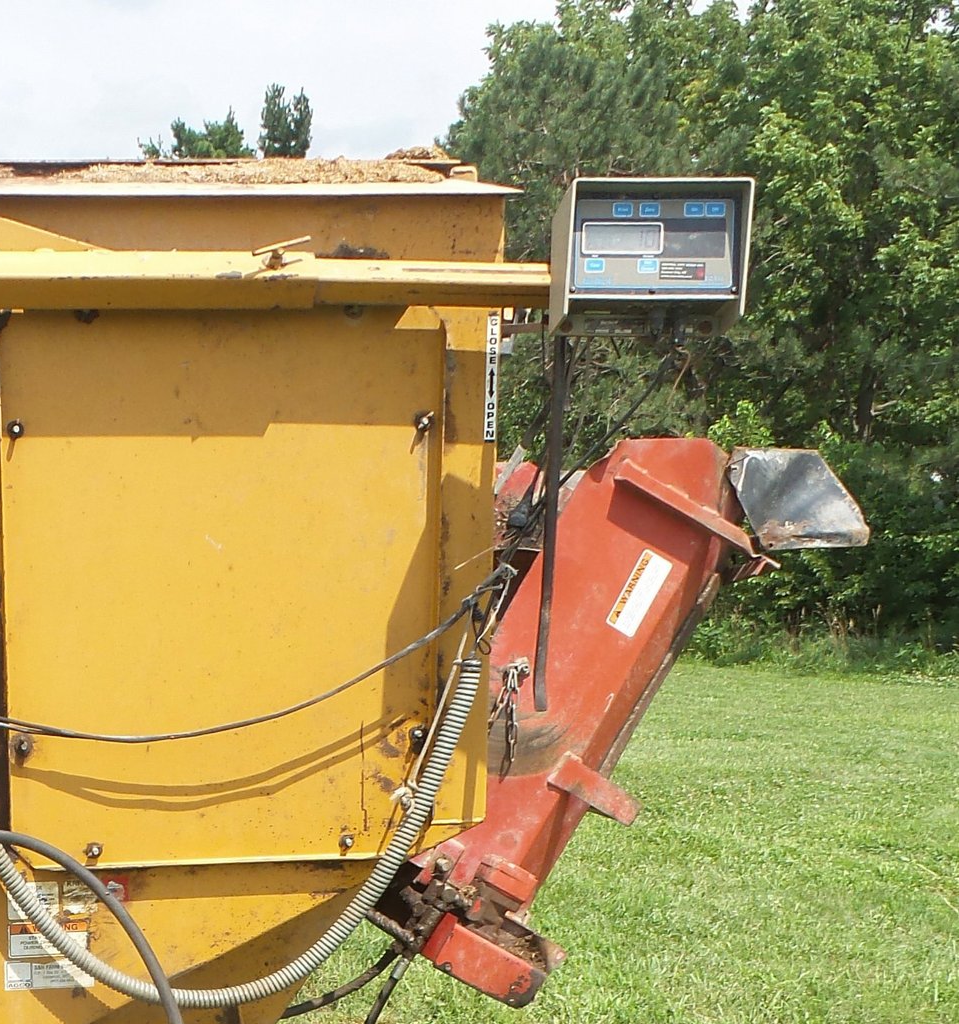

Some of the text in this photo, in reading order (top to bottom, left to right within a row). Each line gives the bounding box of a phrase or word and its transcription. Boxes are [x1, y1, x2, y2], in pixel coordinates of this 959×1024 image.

[488, 318, 498, 365] CLOSE
[485, 402, 495, 438] OPEN
[619, 558, 649, 605] WARNING
